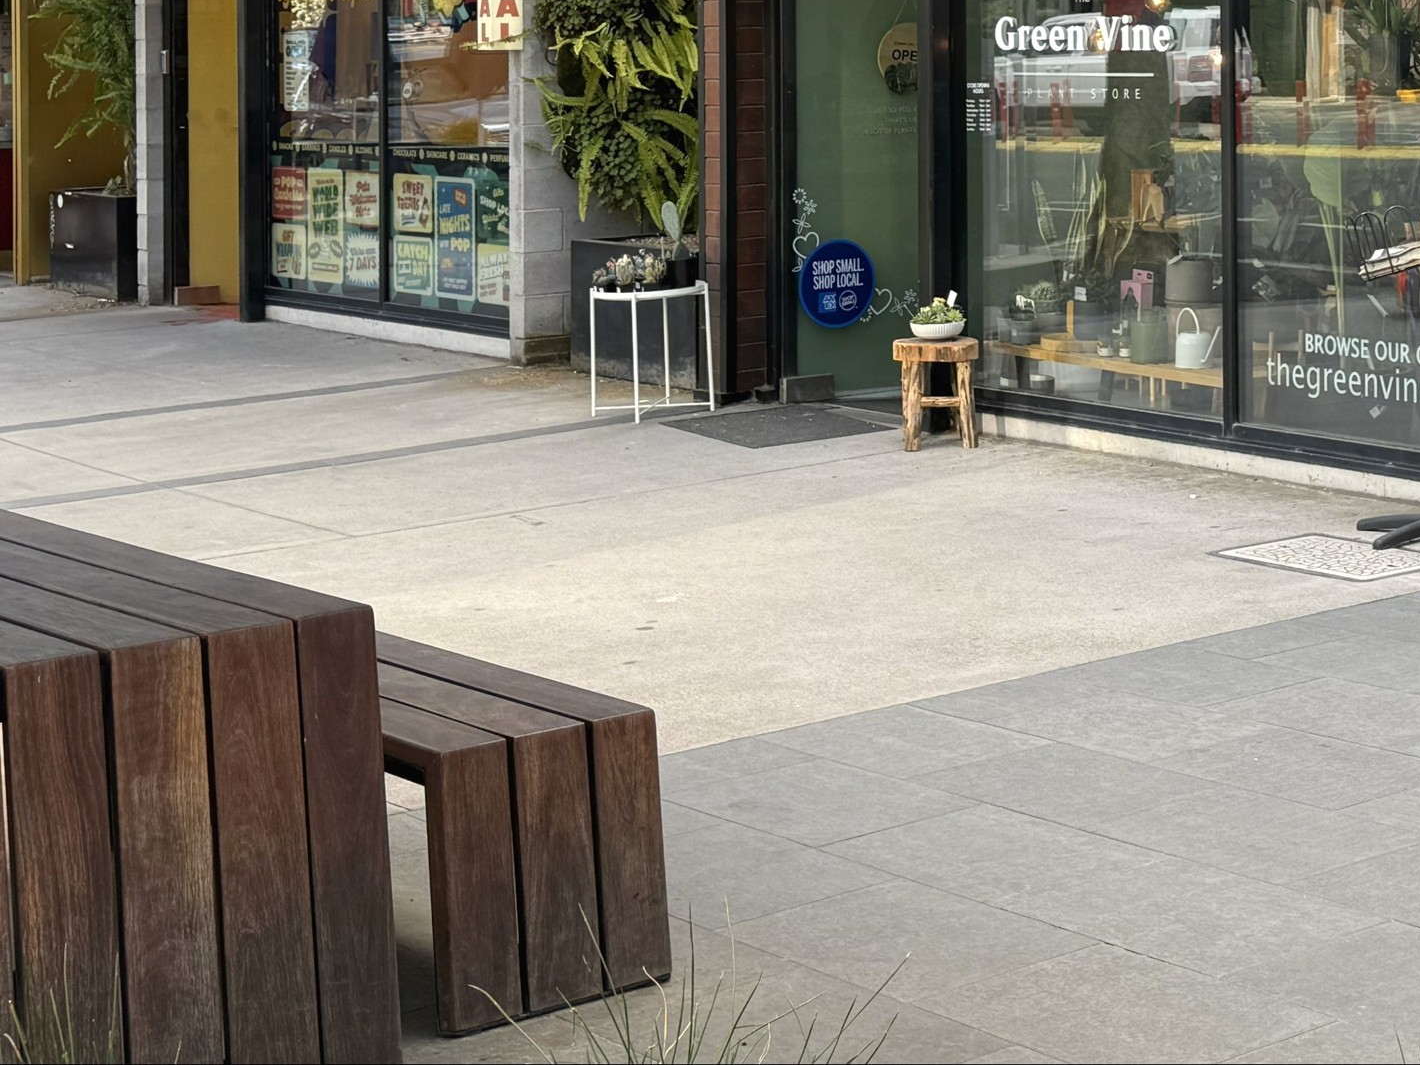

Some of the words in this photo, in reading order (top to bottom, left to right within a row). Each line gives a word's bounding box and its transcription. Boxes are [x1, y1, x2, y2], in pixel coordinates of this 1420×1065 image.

[995, 16, 1085, 51] Green
[1096, 15, 1172, 52] Vine
[892, 49, 918, 61] OPE
[1027, 88, 1075, 99] PLANT
[1091, 88, 1142, 100] STORE
[312, 185, 339, 203] WORLD
[402, 179, 425, 196] SWEET
[312, 202, 339, 219] WIDE
[497, 201, 509, 216] LOC
[438, 214, 471, 234] NIGHTS
[396, 243, 429, 260] CATCH
[450, 237, 470, 252] POP
[356, 256, 377, 271] DAYS
[812, 260, 835, 275] SHOP
[836, 257, 864, 273] SMALL.
[813, 275, 836, 290] SHOP
[836, 272, 863, 288] LOCAL.
[1305, 333, 1369, 359] BROWSE
[1374, 340, 1411, 364] OUR
